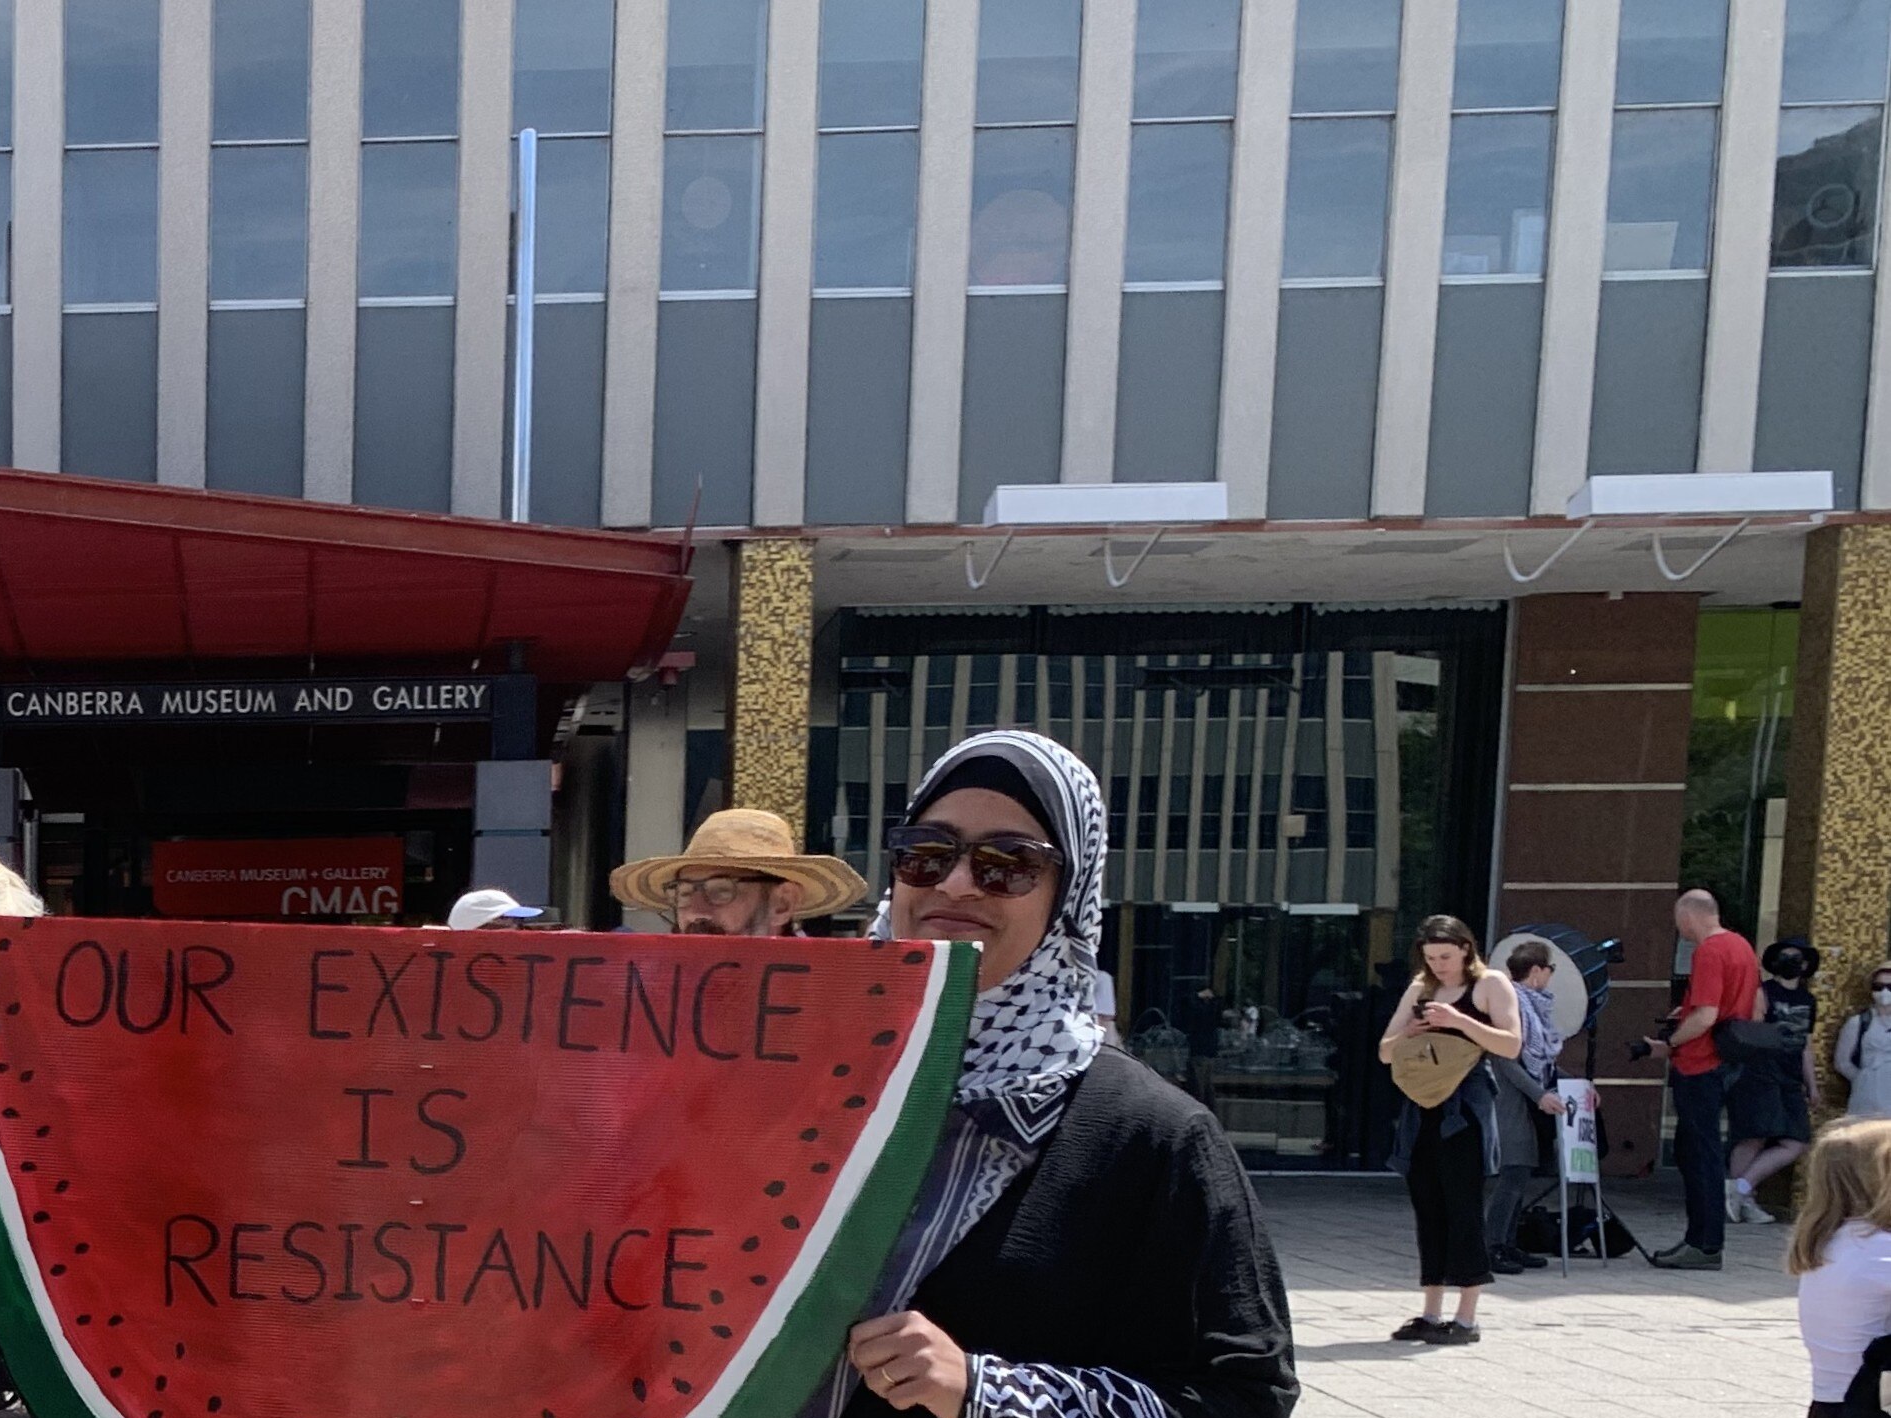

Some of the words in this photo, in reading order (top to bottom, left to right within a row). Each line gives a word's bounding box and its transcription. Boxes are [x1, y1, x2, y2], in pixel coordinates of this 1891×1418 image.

[7, 691, 145, 717] CANBERRA
[161, 688, 277, 714] MUSEUM
[294, 687, 355, 713] AND
[372, 684, 487, 712] GALLERY
[165, 869, 237, 883] CANBERRA
[239, 868, 307, 881] MUSEUM
[321, 867, 390, 880] GALLERY
[280, 885, 400, 915] CMAG
[54, 938, 237, 1037] OUR
[309, 950, 812, 1063] EXISTENCE
[337, 1086, 468, 1173] IS
[164, 1213, 715, 1313] RESISTANCE
